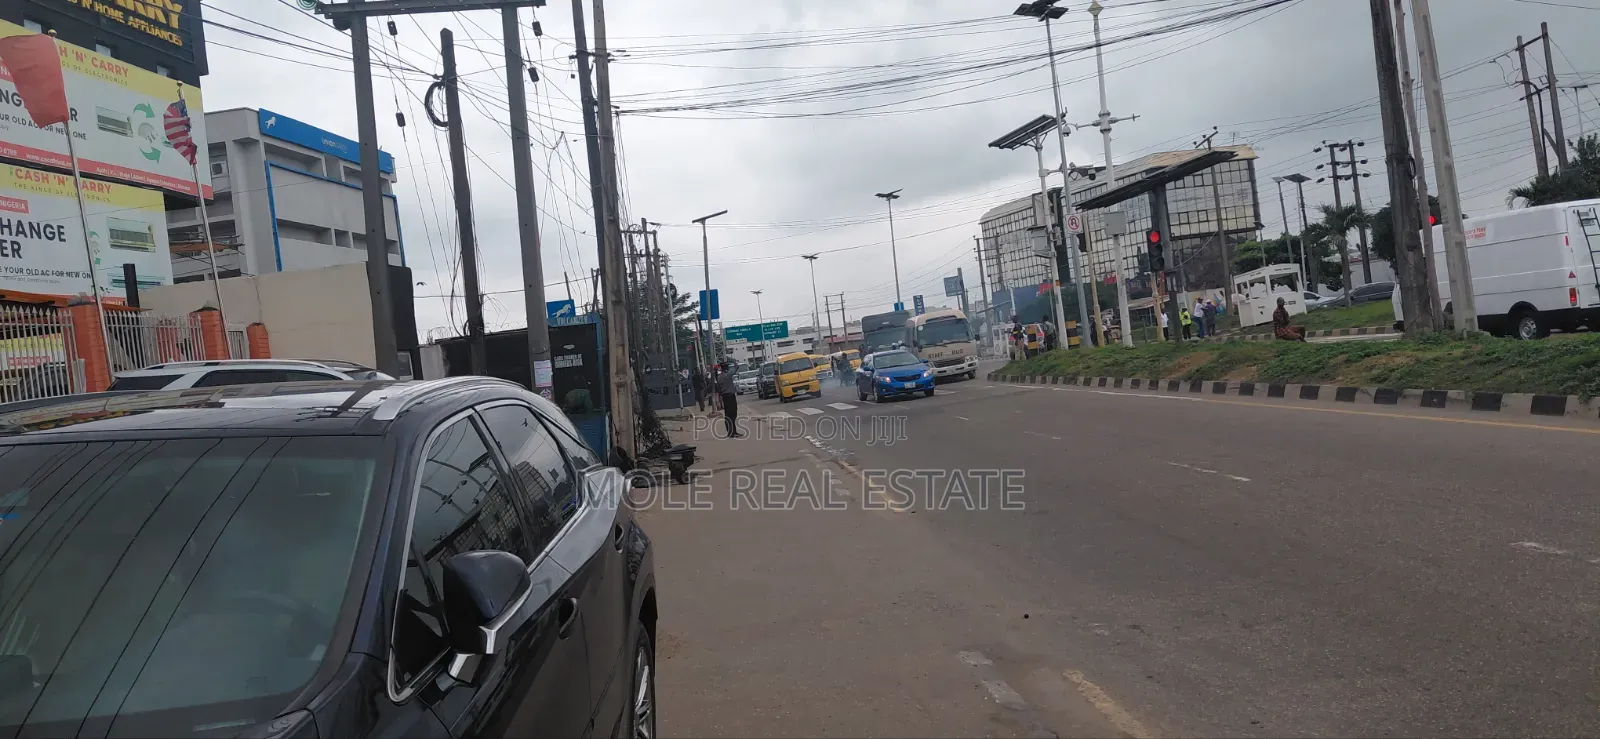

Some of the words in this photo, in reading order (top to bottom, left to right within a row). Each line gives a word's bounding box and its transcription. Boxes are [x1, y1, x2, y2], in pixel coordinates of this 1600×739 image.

[94, 2, 125, 24] HOME
[127, 16, 183, 47] APPLIANCES
[71, 51, 87, 64] 'N'
[91, 56, 129, 79] CARRY
[84, 68, 129, 88] ELECTRONICS
[11, 116, 27, 126] OLD
[55, 127, 70, 137] NEW
[72, 130, 88, 141] ONE
[14, 167, 51, 185] CASH
[53, 175, 69, 187] 'N'
[13, 182, 28, 190] THE
[31, 186, 53, 195] KINGS
[3, 265, 25, 275] YOUR
[25, 268, 40, 277] OLD
[40, 269, 51, 277] AC
[51, 270, 65, 278] FOR
[65, 271, 81, 279] NEW
[928, 351, 944, 359] STAFF
